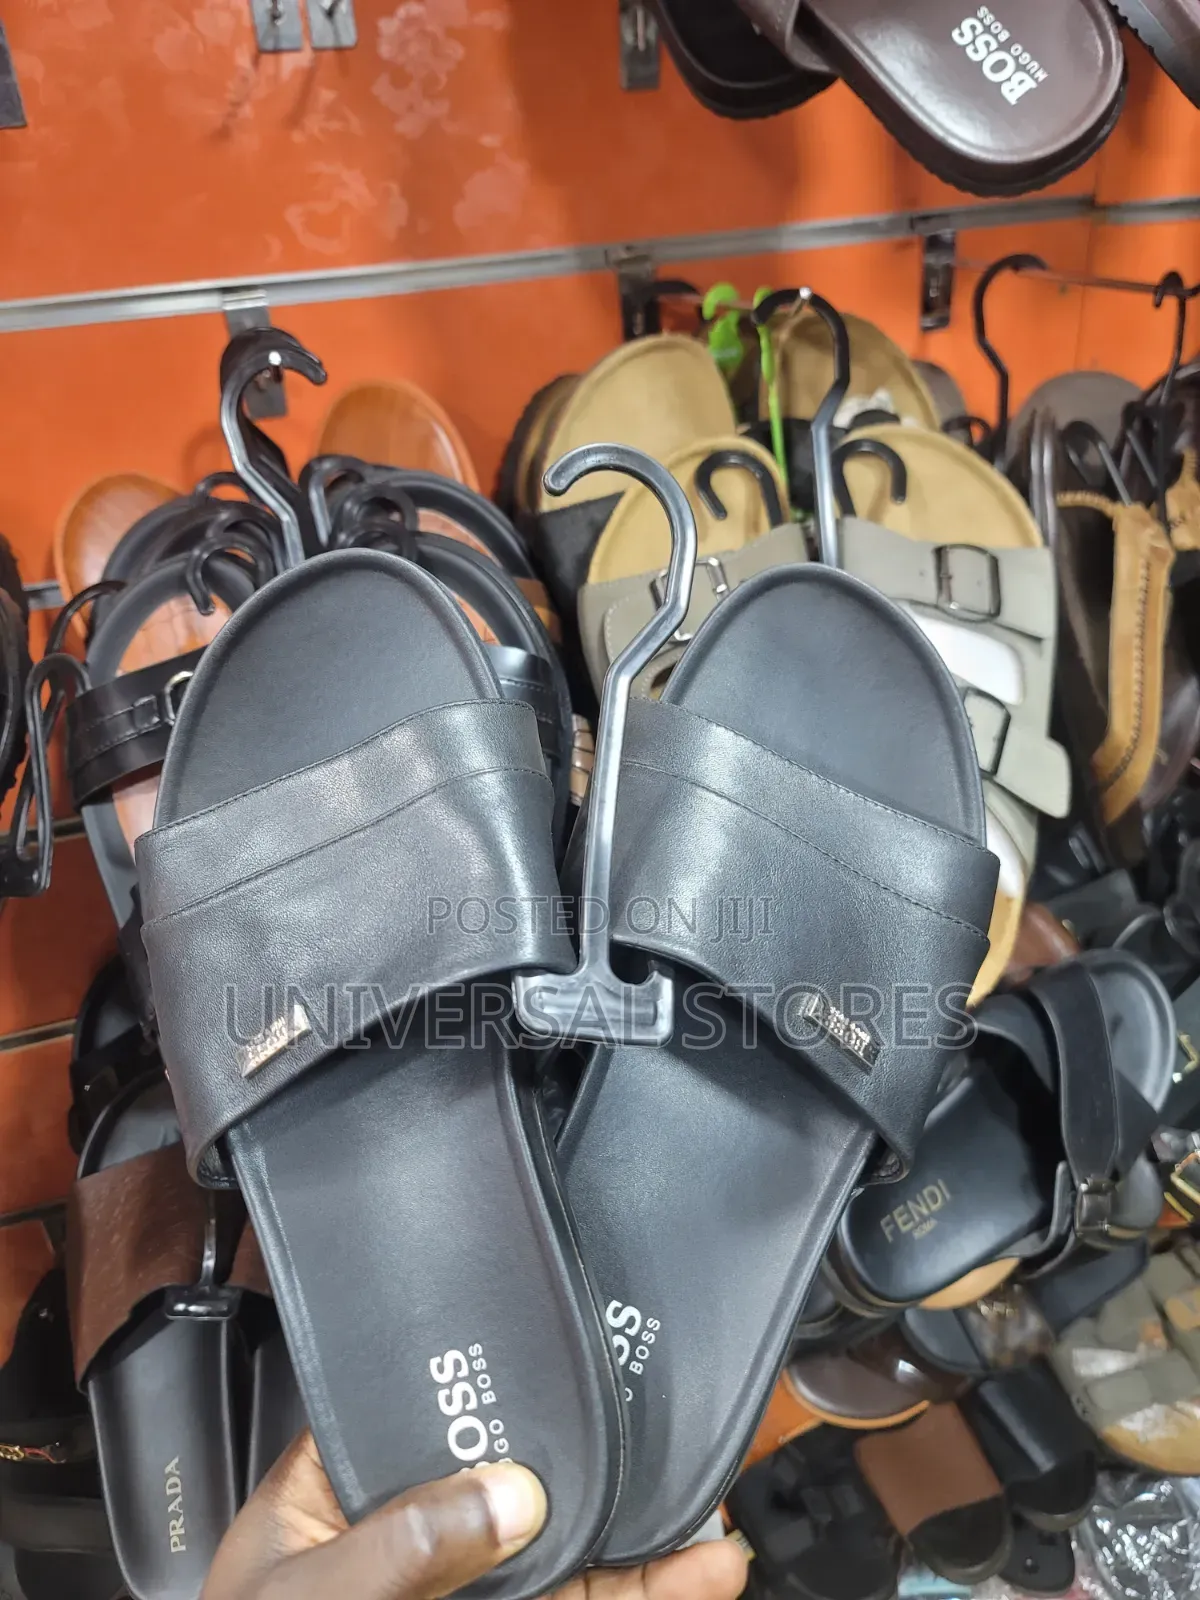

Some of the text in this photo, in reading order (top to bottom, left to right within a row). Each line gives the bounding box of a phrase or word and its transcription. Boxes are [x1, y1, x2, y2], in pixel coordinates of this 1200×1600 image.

[951, 17, 1038, 105] BOSS
[976, 5, 1049, 83] HUGO BOSS
[880, 1178, 951, 1243] FENDI
[468, 1343, 497, 1405] BOSS
[628, 1317, 661, 1375] BOSS
[429, 1349, 489, 1472] OSS
[164, 1455, 187, 1553] PRADA
